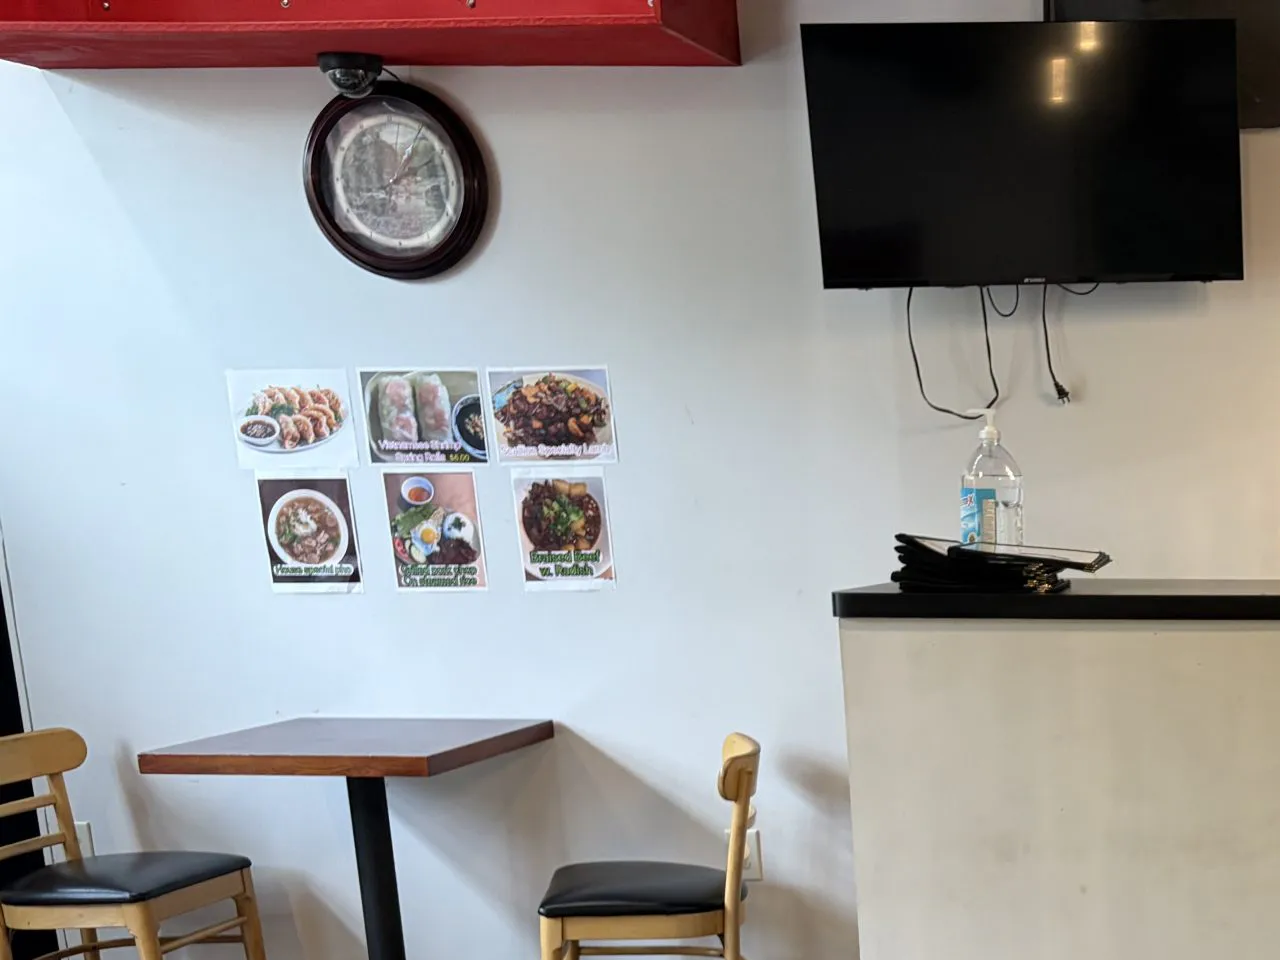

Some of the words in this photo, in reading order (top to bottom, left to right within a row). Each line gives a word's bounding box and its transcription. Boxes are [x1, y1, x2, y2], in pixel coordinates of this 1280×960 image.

[378, 439, 429, 450] Vietnamese
[430, 438, 461, 451] Shrimp
[395, 452, 423, 463] Spring
[424, 451, 447, 462] Rolls
[573, 549, 601, 563] Beef
[555, 563, 594, 577] Radish
